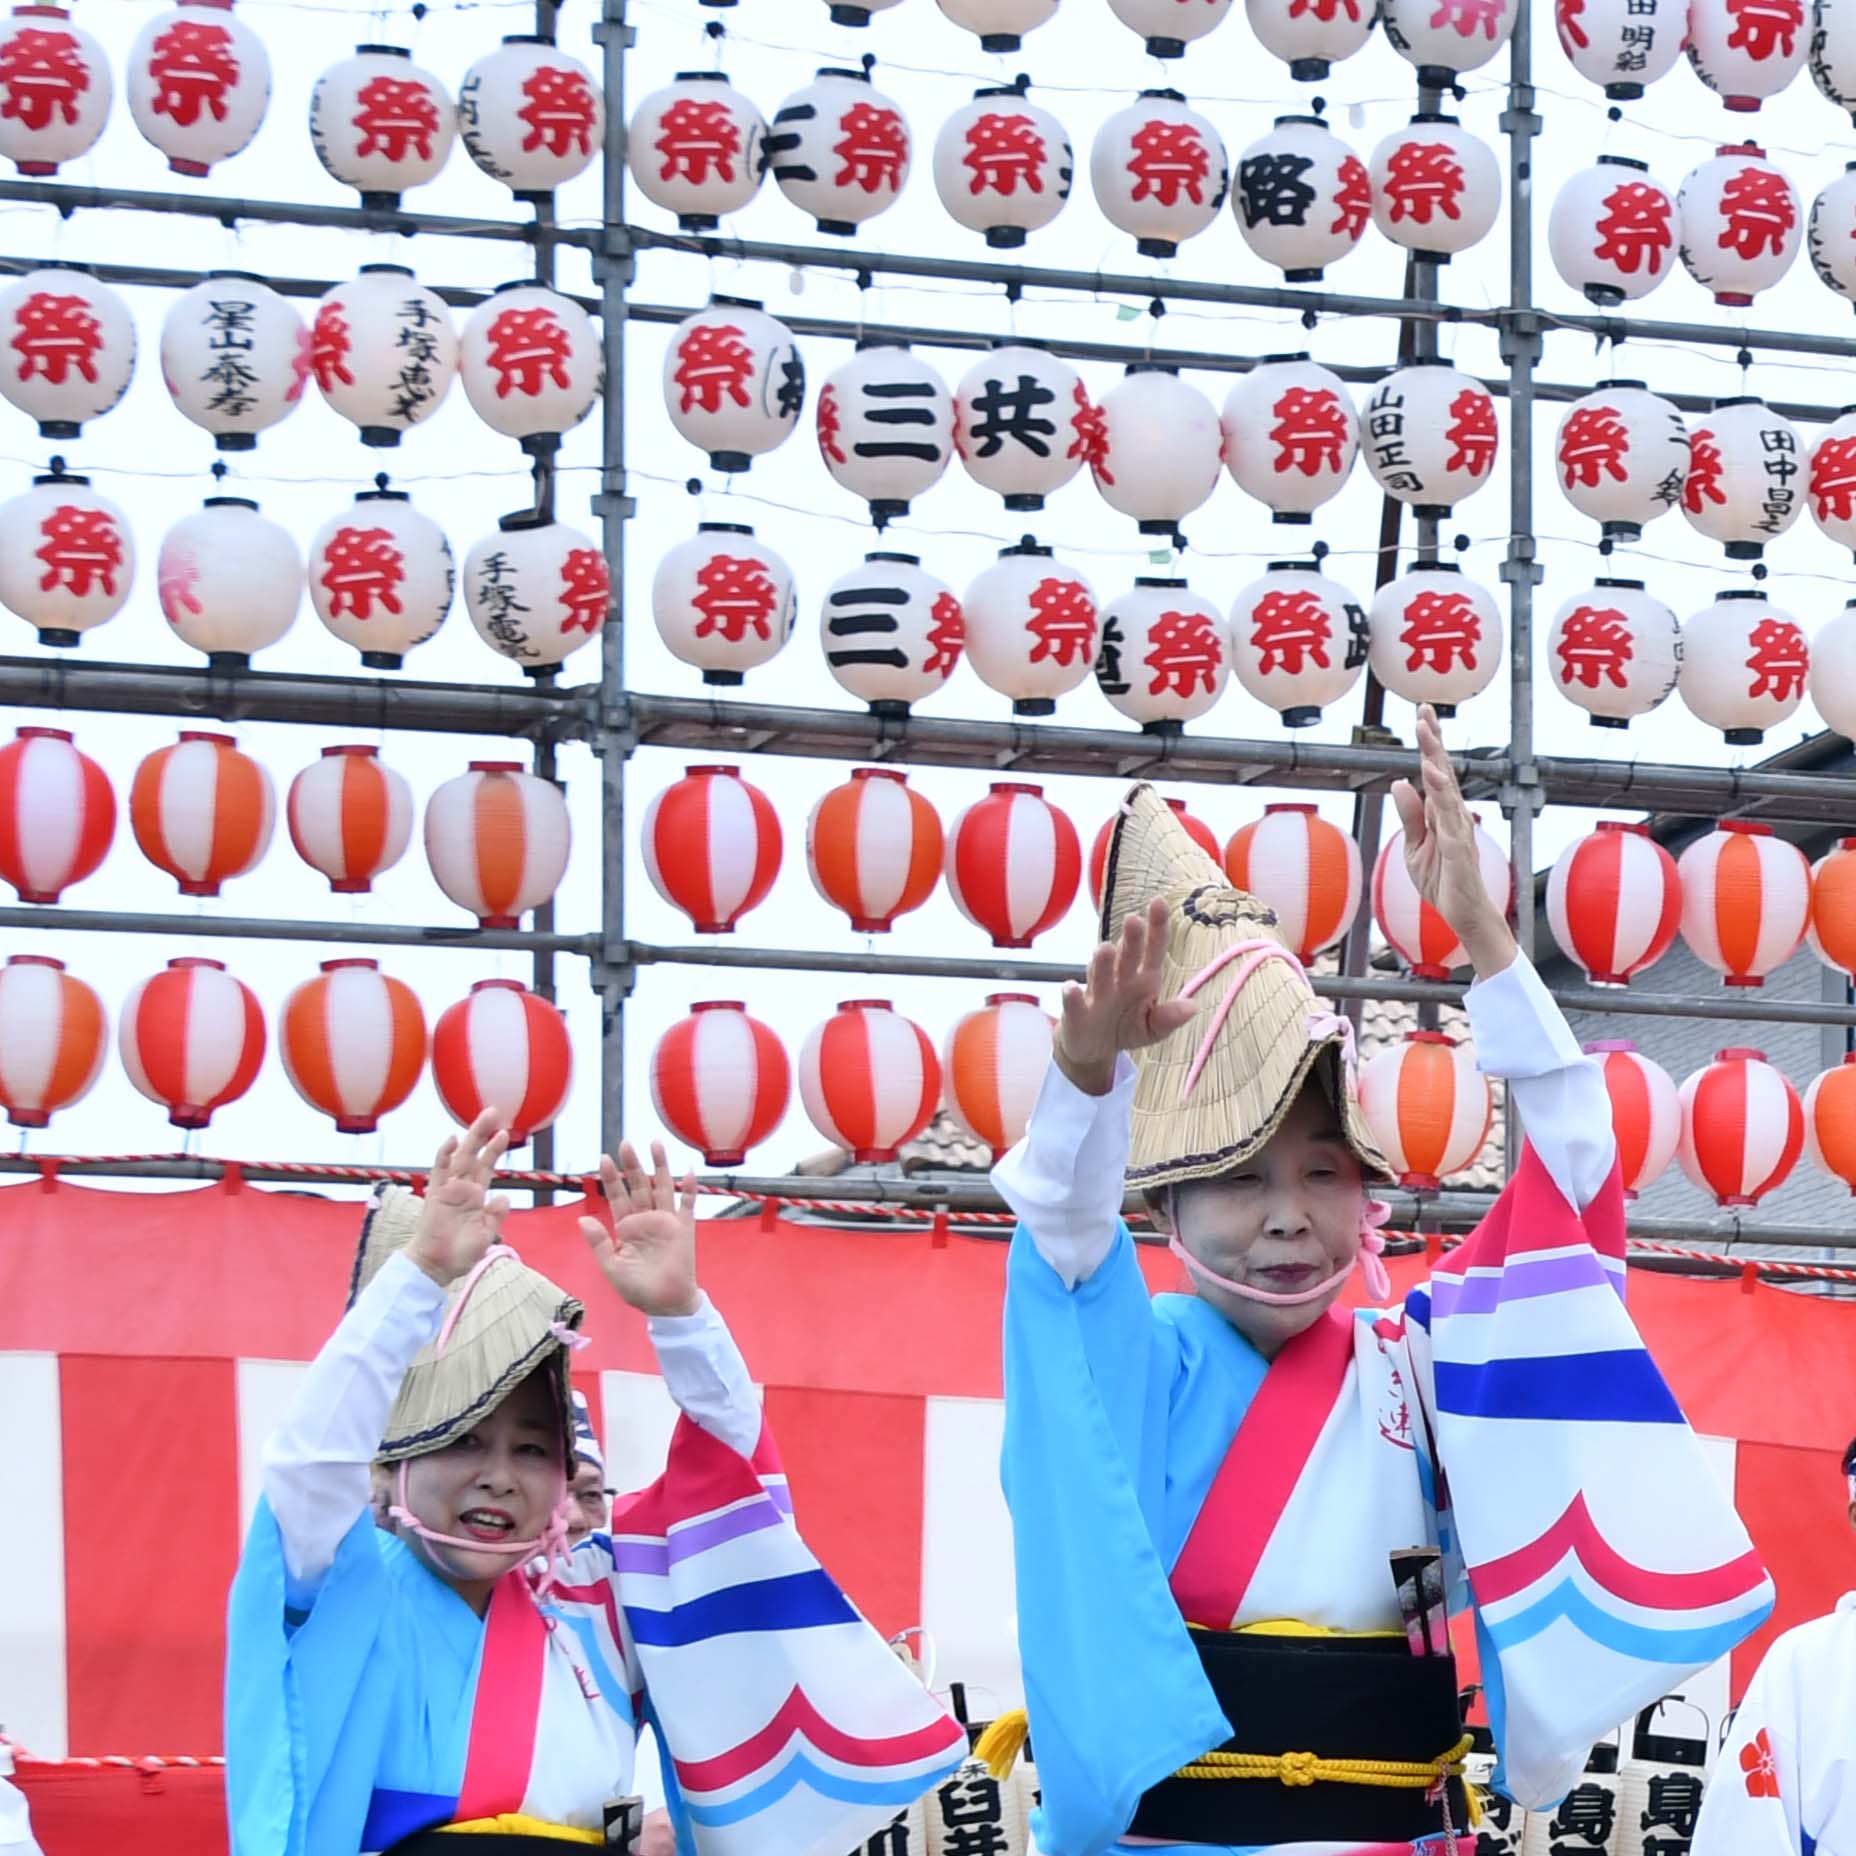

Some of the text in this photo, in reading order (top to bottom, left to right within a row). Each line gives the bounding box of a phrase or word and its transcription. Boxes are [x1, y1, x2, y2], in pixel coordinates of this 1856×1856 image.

[0, 31, 87, 132] 祭
[150, 22, 237, 126] 祭
[519, 67, 596, 158] 祭
[353, 77, 439, 164] 祭
[655, 99, 741, 186] 祭
[834, 103, 906, 194] 祭
[962, 113, 1046, 197] 祭
[1127, 120, 1208, 207] 祭
[1240, 154, 1317, 230] 路
[1382, 143, 1465, 224] 祭
[1717, 168, 1795, 261] 祭
[1594, 184, 1672, 275] 祭
[11, 294, 102, 385] 祭
[486, 309, 572, 400] 祭
[673, 326, 752, 414] 祭
[853, 382, 940, 462] 三
[969, 373, 1057, 458] 共
[1269, 387, 1348, 477] 祭
[1371, 386, 1425, 493] 山田正司
[1559, 407, 1629, 489] 祭
[36, 506, 123, 598] 祭
[320, 528, 404, 621] 祭
[691, 555, 776, 643] 祭
[829, 586, 910, 668] 三
[1025, 578, 1097, 667] 祭
[1250, 591, 1332, 676] 祭
[1400, 591, 1482, 675] 祭
[1144, 611, 1223, 700] 祭
[1557, 607, 1633, 688] 祭
[1746, 619, 1810, 703] 祭
